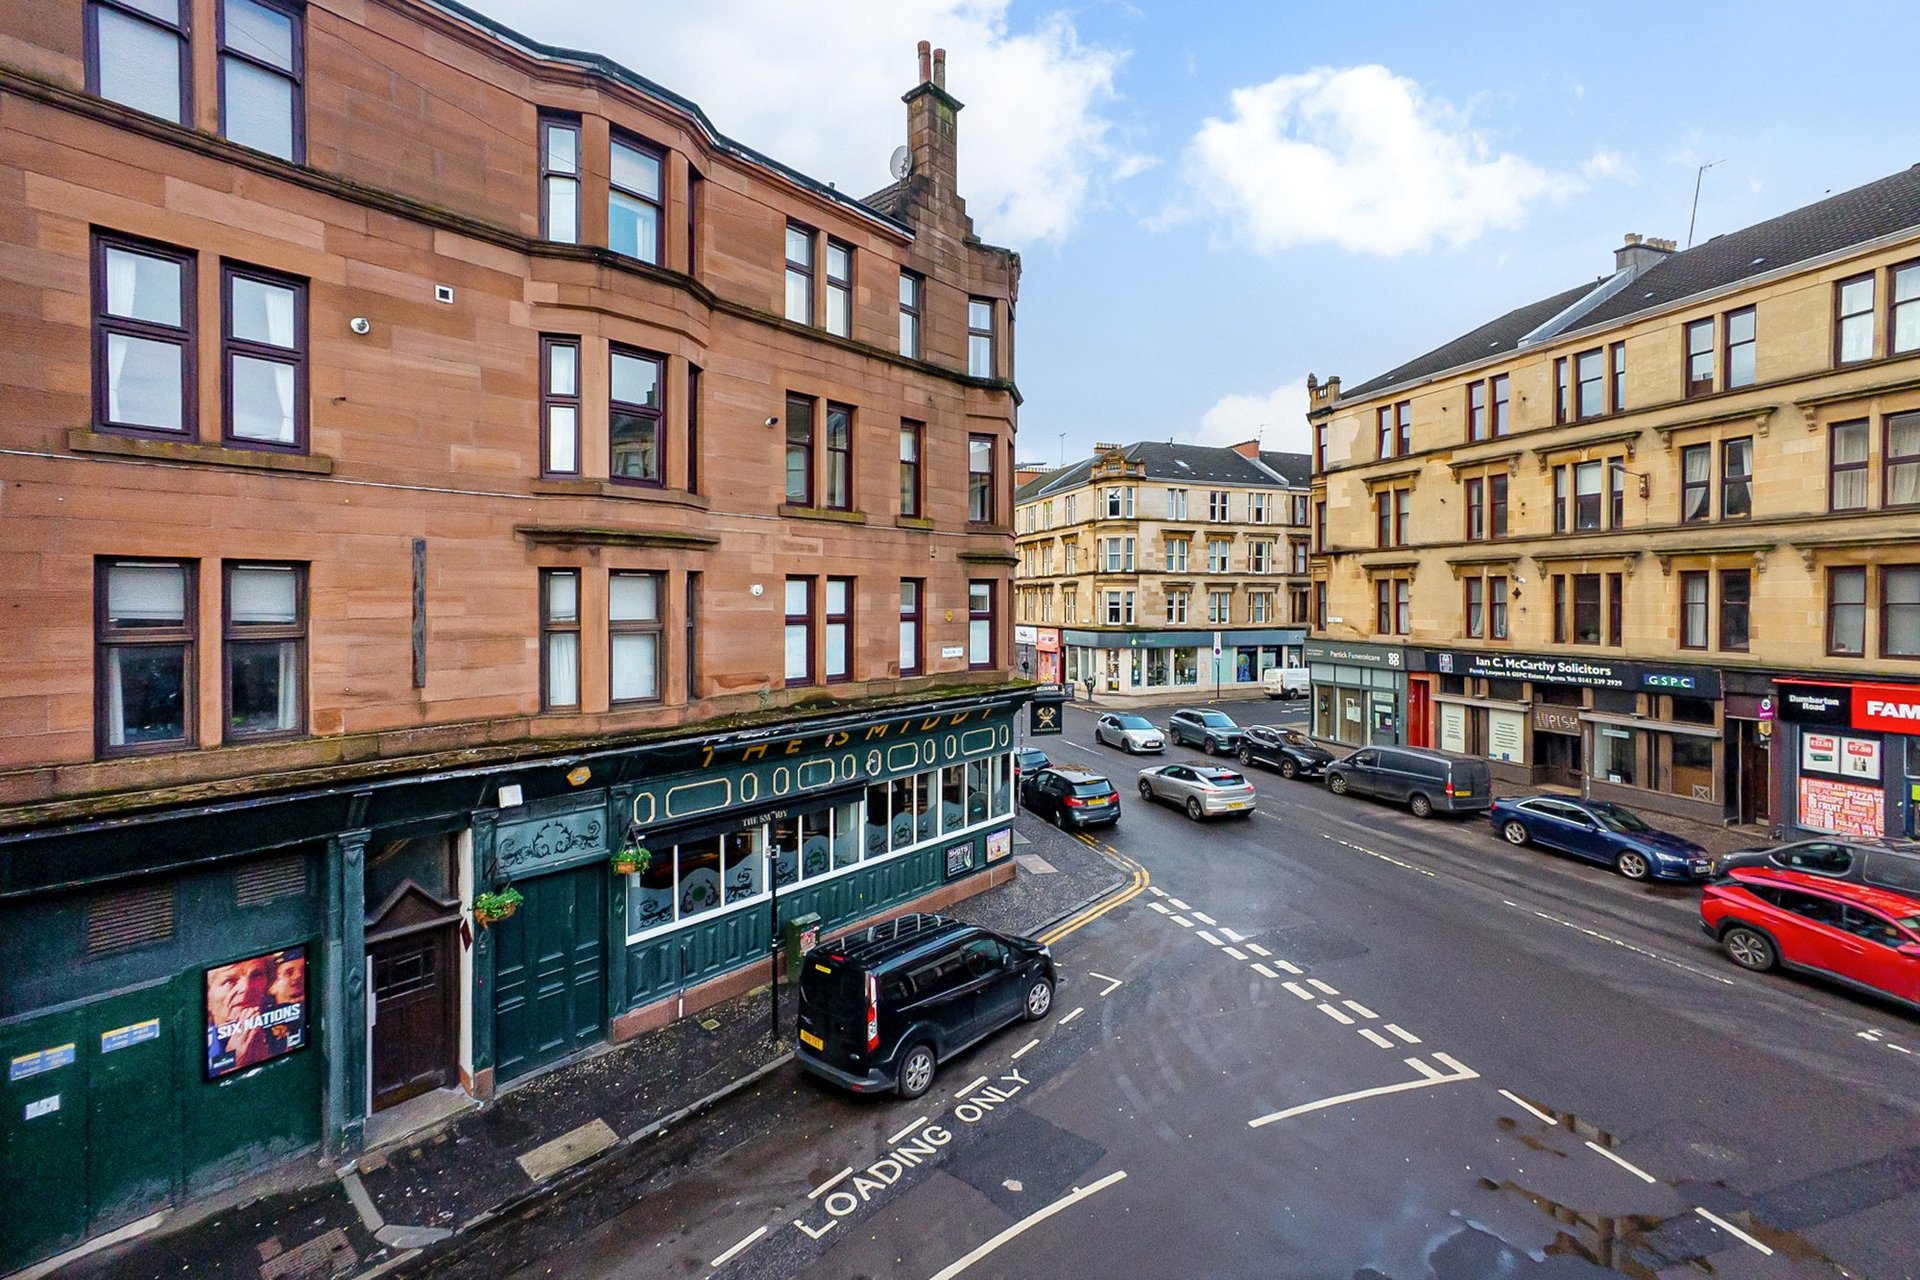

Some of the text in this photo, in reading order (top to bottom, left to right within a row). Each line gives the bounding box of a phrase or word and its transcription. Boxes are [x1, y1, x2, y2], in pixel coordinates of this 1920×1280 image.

[1476, 657, 1612, 676] Ian C. McCarthy Solicitors
[1789, 694, 1840, 706] Dumbarton
[1802, 702, 1826, 712] Road
[1867, 700, 1920, 720] FAM
[1847, 790, 1873, 803] PIZZA
[1818, 801, 1842, 812] FRUIT
[218, 1021, 242, 1040] SIX
[244, 1003, 301, 1032] NATIONS
[794, 1068, 1030, 1240] LOADING ONLY
